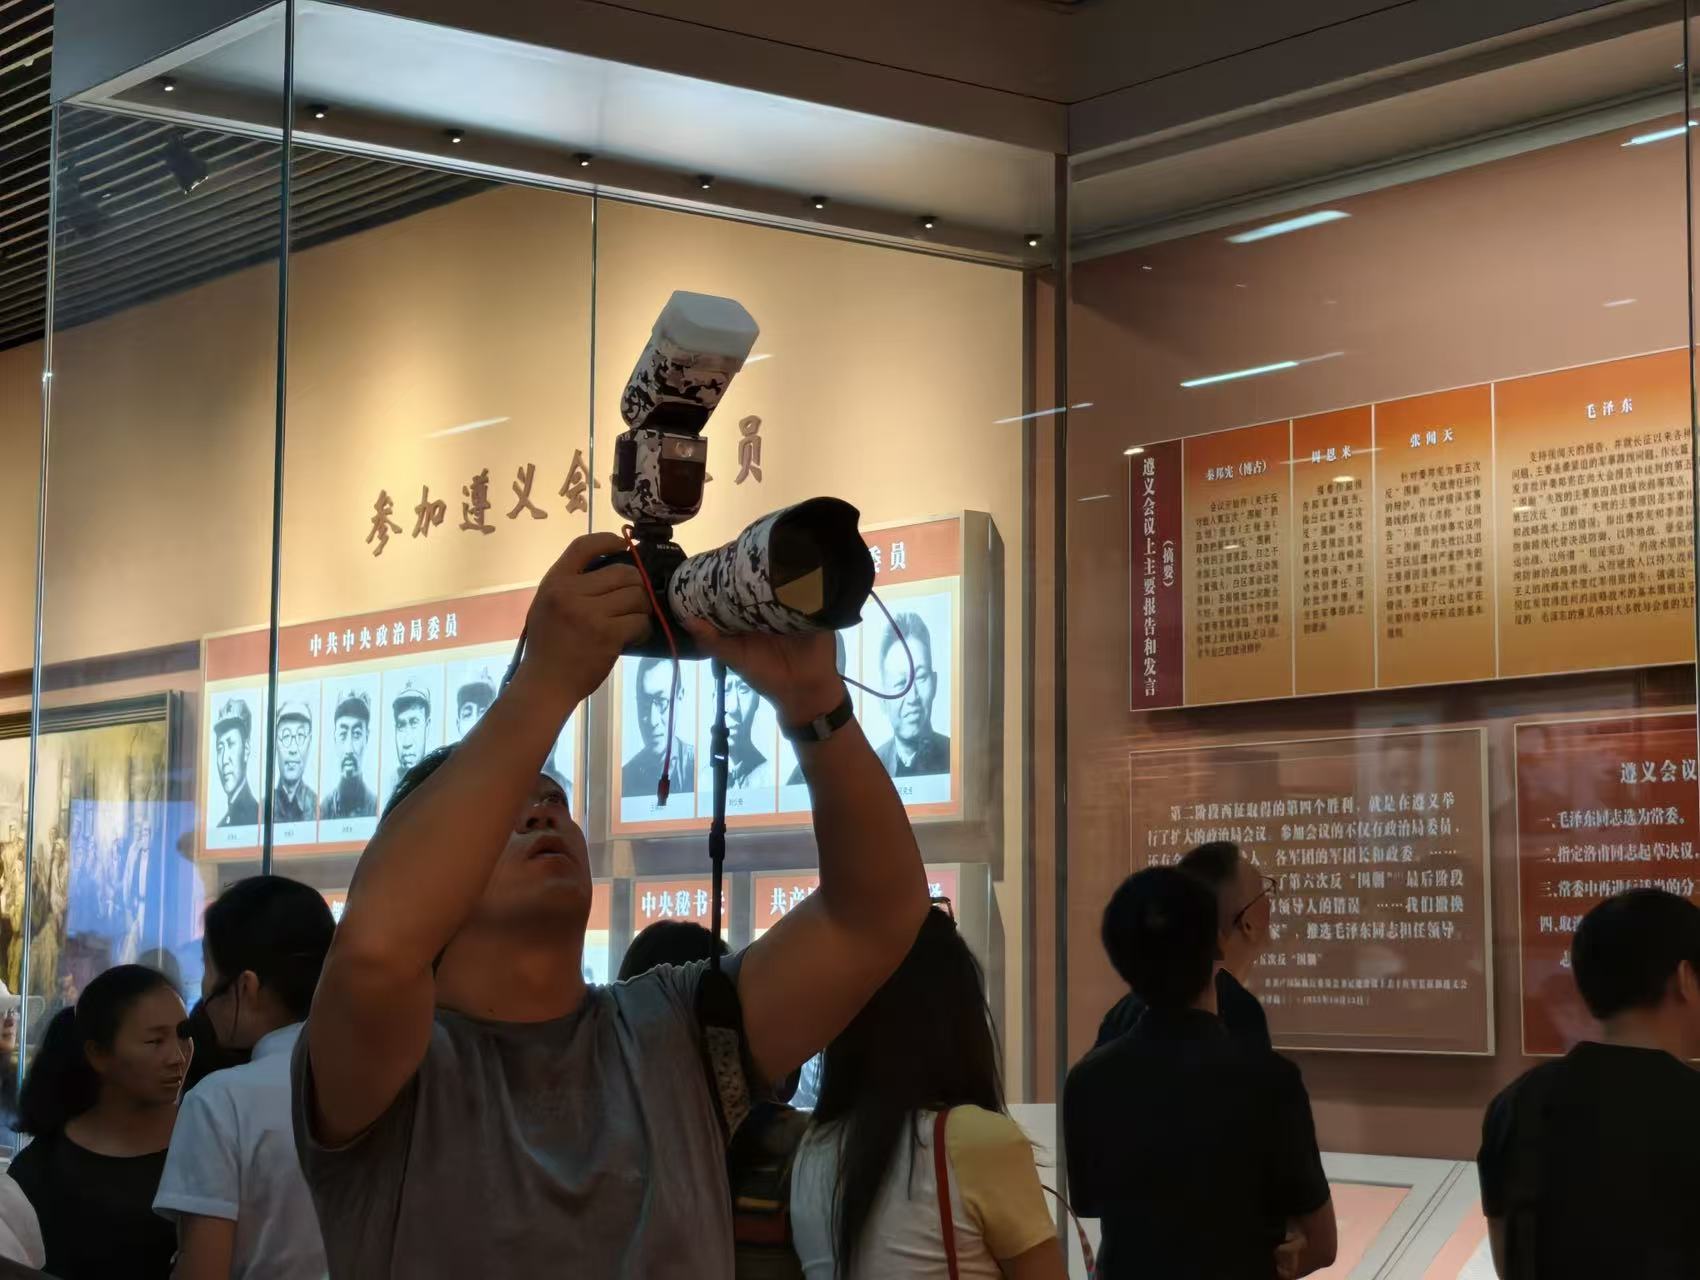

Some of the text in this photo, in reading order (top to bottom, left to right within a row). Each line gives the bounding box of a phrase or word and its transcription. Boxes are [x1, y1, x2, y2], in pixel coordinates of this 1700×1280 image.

[1586, 398, 1633, 419] 毛泽东
[1409, 429, 1455, 447] 张闻天
[365, 414, 763, 557] 参加遵义会员
[1143, 457, 1158, 697] 遵义会议上主要报告和发言
[310, 612, 459, 658] 中共中央政治局委员
[1619, 759, 1697, 784] 遵义会议
